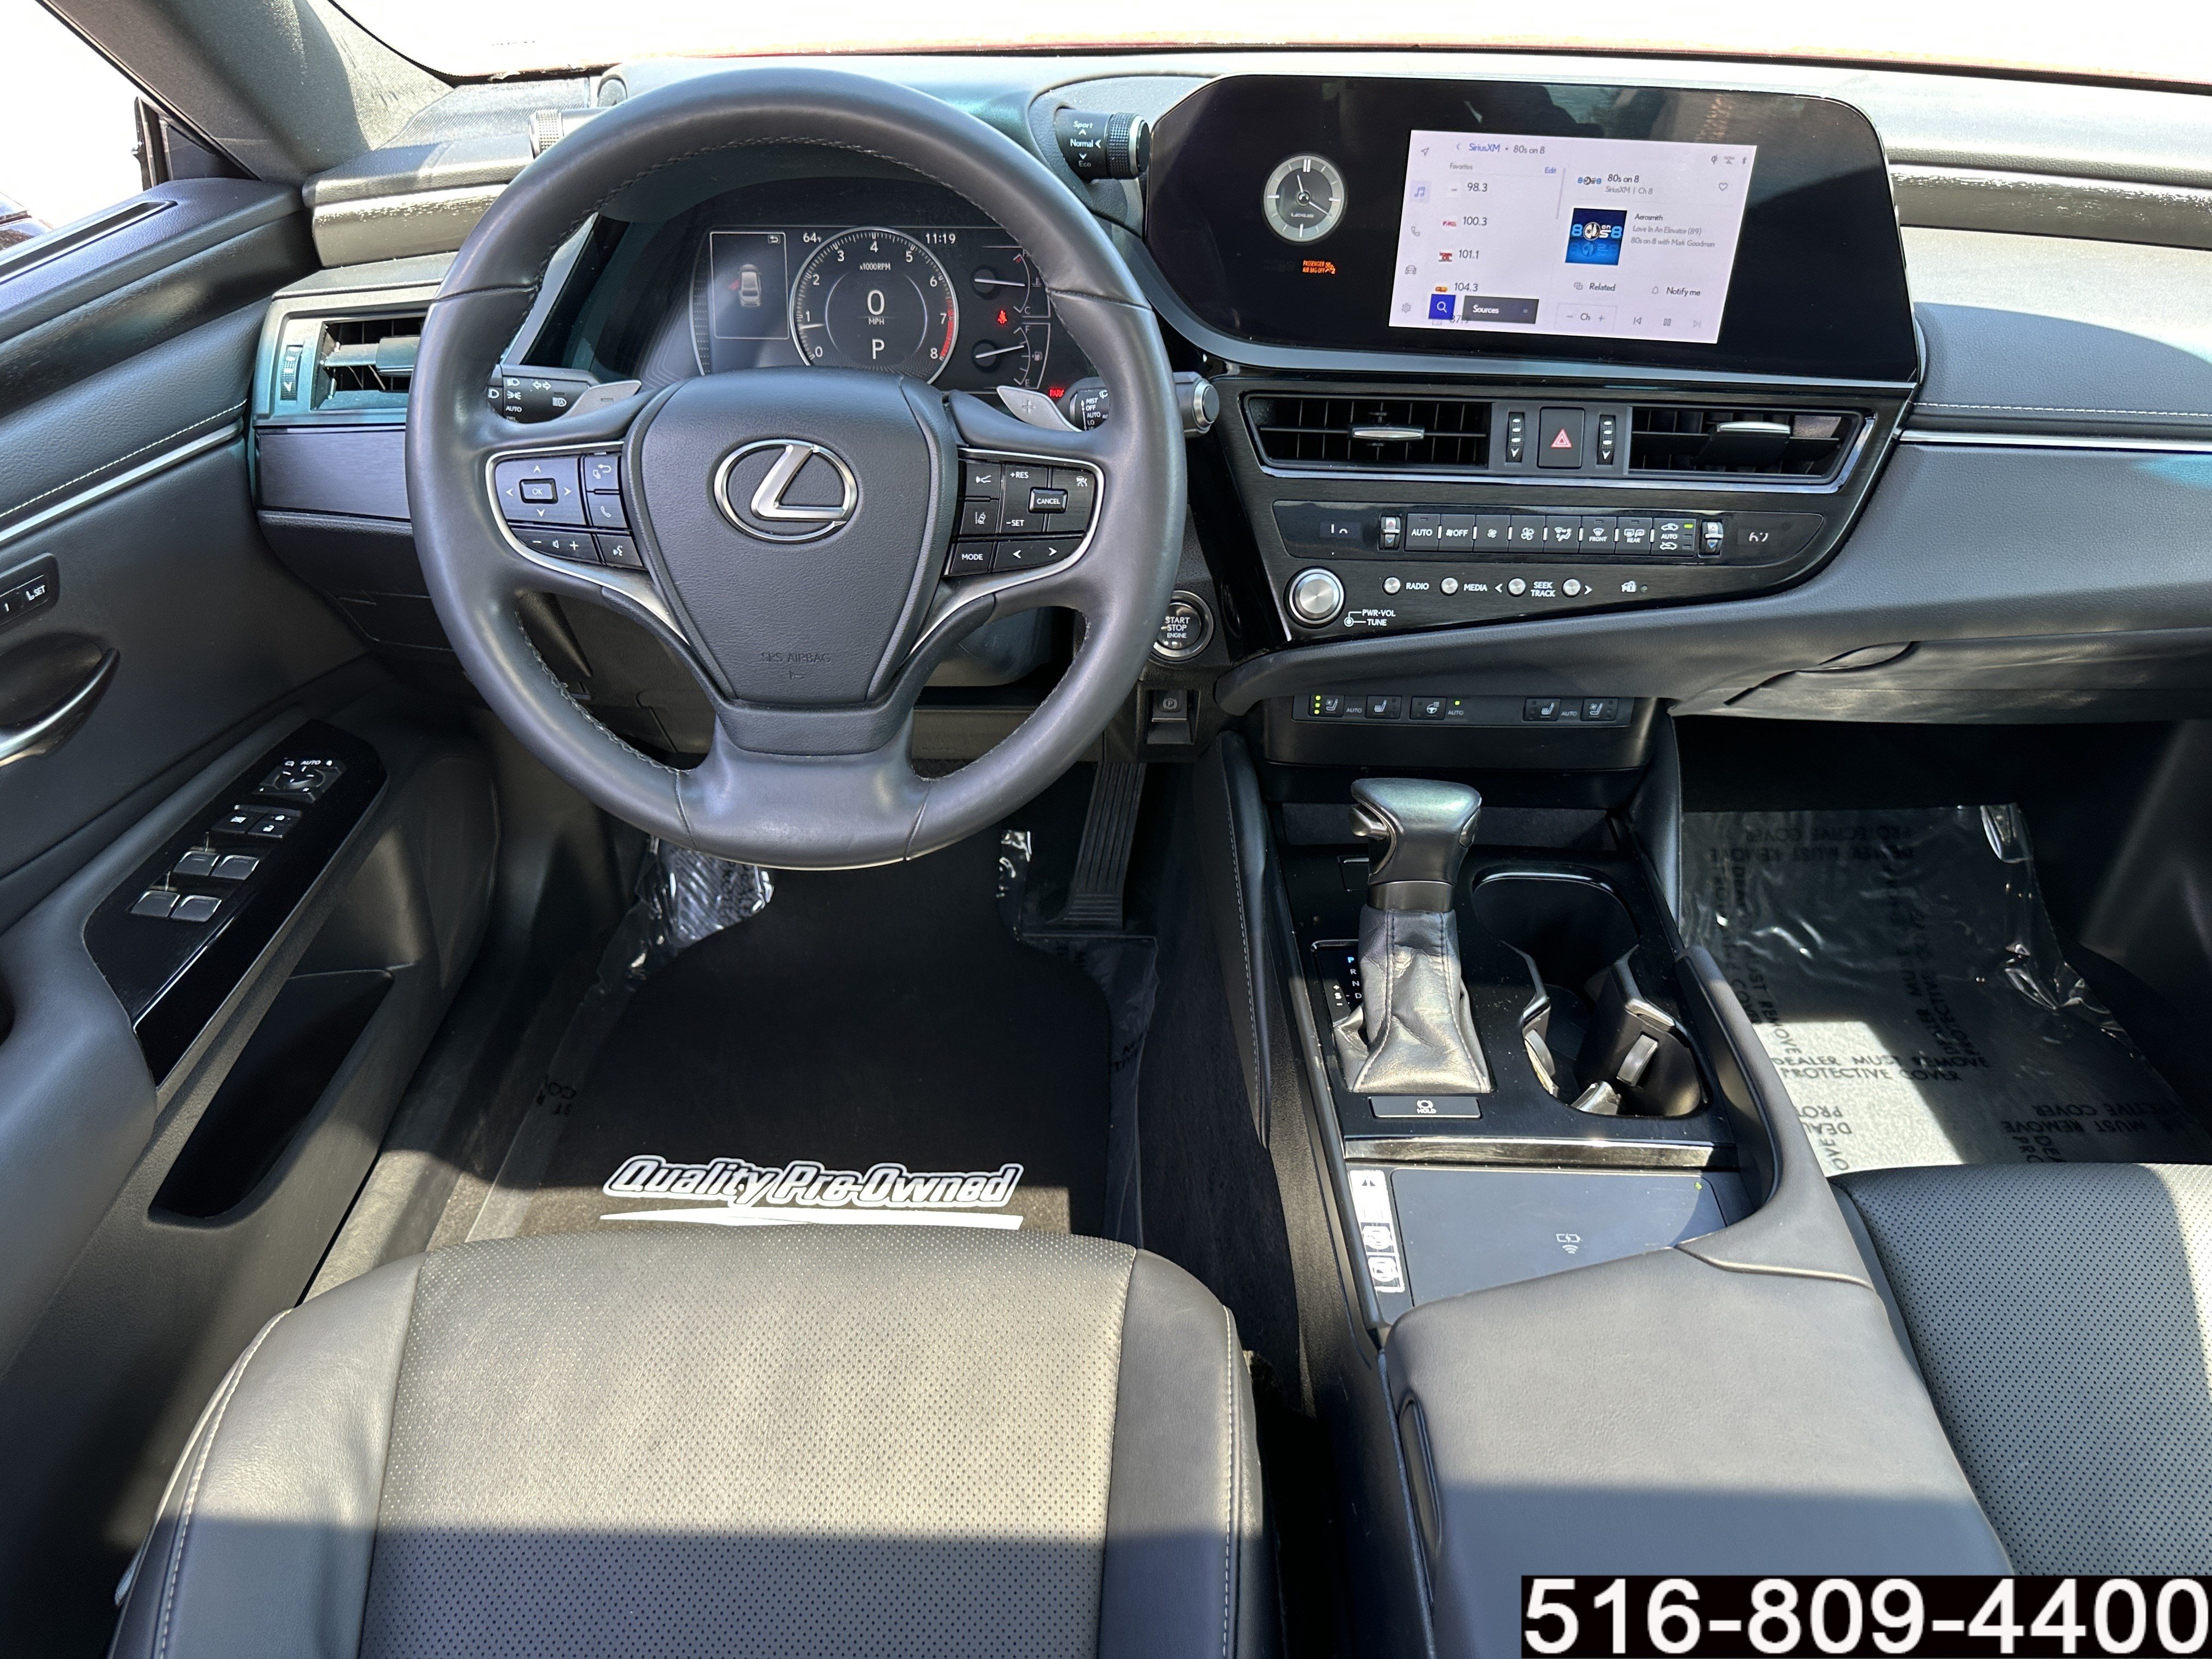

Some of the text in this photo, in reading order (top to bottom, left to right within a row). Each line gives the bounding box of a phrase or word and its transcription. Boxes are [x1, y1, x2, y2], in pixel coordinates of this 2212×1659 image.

[1073, 121, 1093, 129] Sport
[1070, 139, 1093, 148] Normal
[1469, 143, 1500, 153] SiriusXM
[1513, 145, 1527, 154] 80s
[1539, 146, 1545, 154] 8
[1607, 174, 1622, 183] 80s
[1634, 174, 1640, 183] 8
[1467, 182, 1488, 192] 98.3
[1463, 216, 1488, 226] 100.3
[925, 233, 956, 245] 11:19
[869, 241, 879, 253] 4
[837, 251, 845, 262] 3
[905, 250, 913, 263] 5
[1458, 250, 1480, 259] 101.1
[812, 274, 820, 285] 2
[929, 276, 938, 287] 6
[1454, 282, 1479, 292] 104.3
[1589, 283, 1616, 292] Related
[1666, 286, 1689, 297] Notify
[867, 289, 885, 315] 0
[1024, 306, 1031, 315] C
[1472, 304, 1499, 314] Sources
[805, 311, 811, 322] 1
[939, 313, 947, 324] 7
[1579, 313, 1590, 321] Ch
[814, 346, 823, 358] 0
[871, 338, 885, 359] P
[929, 348, 939, 359] 8
[1049, 388, 1065, 397] PARK
[1410, 528, 1433, 537] AUTO
[1453, 529, 1469, 537] OFF
[1406, 582, 1430, 590] RADIO
[1463, 583, 1488, 591] MEDIA
[1533, 581, 1553, 590] SEEK
[1530, 589, 1556, 597] TRACK
[1165, 616, 1190, 624] START
[1367, 618, 1387, 627] TUNE
[787, 652, 832, 663] AIRBAG
[1771, 1055, 1841, 1067] DEALER
[1852, 1054, 1901, 1067] MUST
[1780, 1066, 1963, 1082] PROTECTIVE COVER
[605, 1155, 1024, 1206] Quality Pre-Owned
